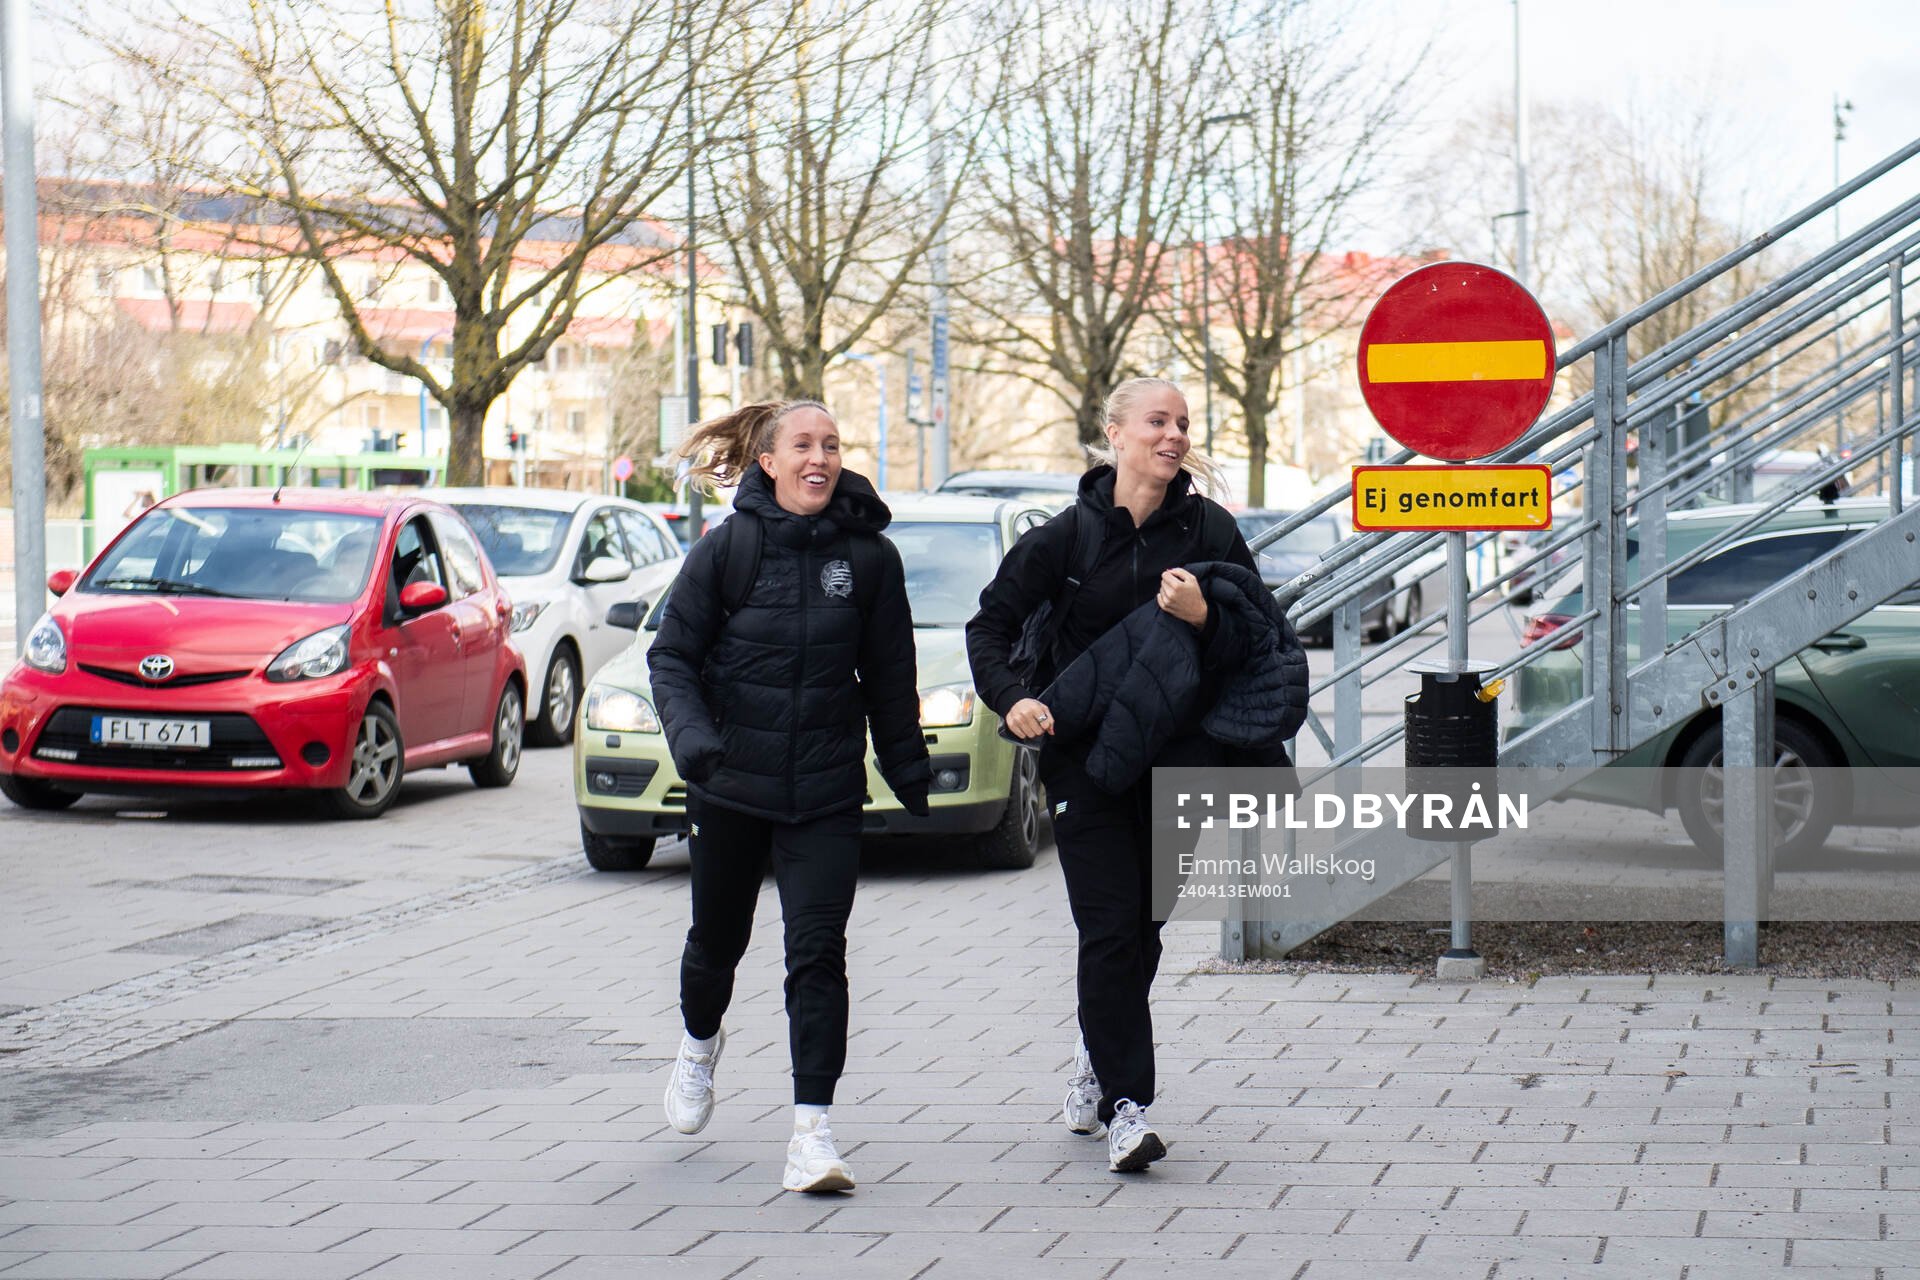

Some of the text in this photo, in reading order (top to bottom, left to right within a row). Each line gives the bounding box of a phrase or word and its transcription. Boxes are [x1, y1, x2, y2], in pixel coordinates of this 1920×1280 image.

[1365, 487, 1538, 512] Ej genomfart
[111, 720, 198, 743] FLT 671
